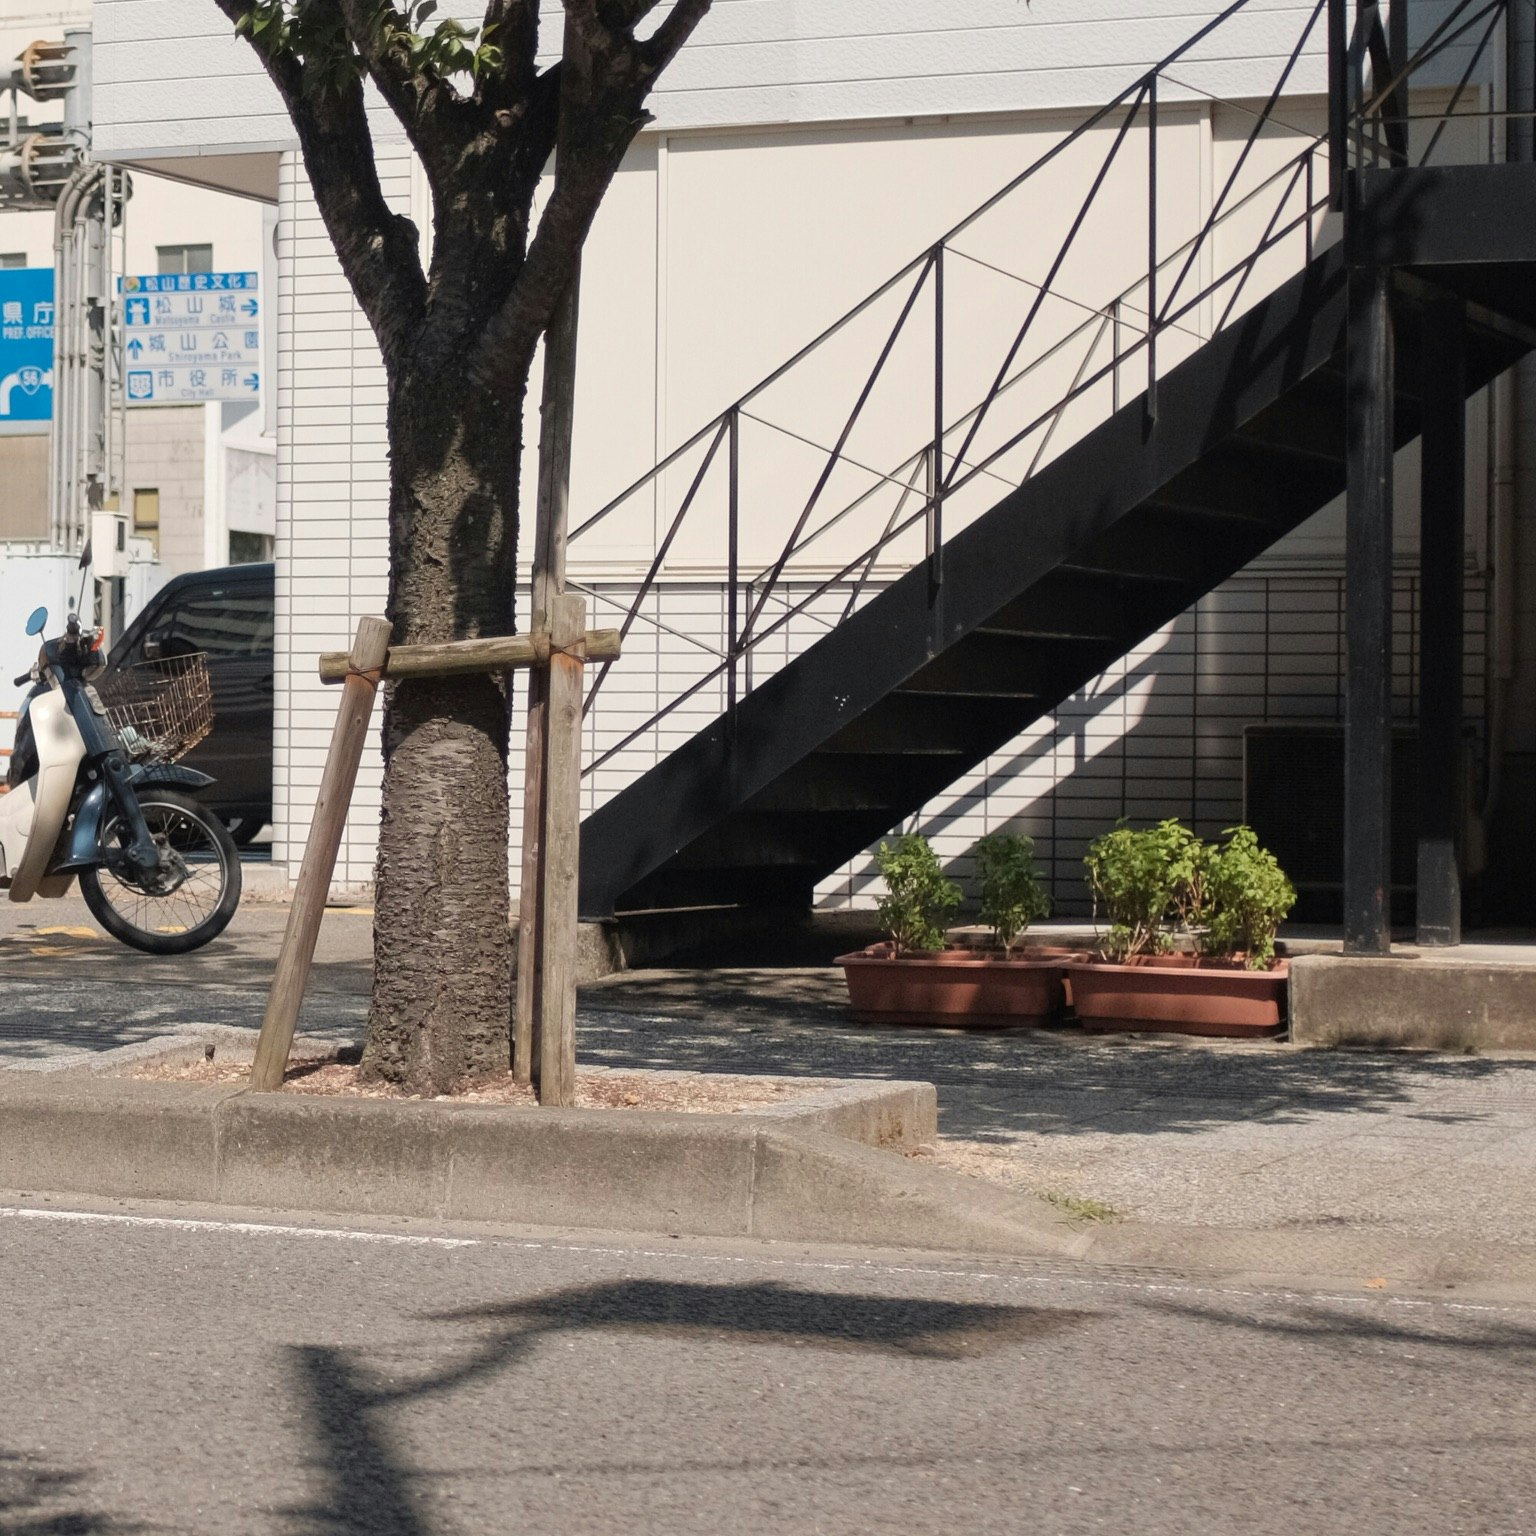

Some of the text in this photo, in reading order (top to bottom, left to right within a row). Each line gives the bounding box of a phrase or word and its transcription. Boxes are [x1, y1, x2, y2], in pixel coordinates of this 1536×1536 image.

[2, 302, 54, 324] 県庁
[156, 295, 236, 314] 松山城
[149, 331, 258, 352] 城山公園
[169, 351, 241, 363] Shiroyama Park
[22, 370, 38, 386] 56
[158, 369, 237, 387] 市役所
